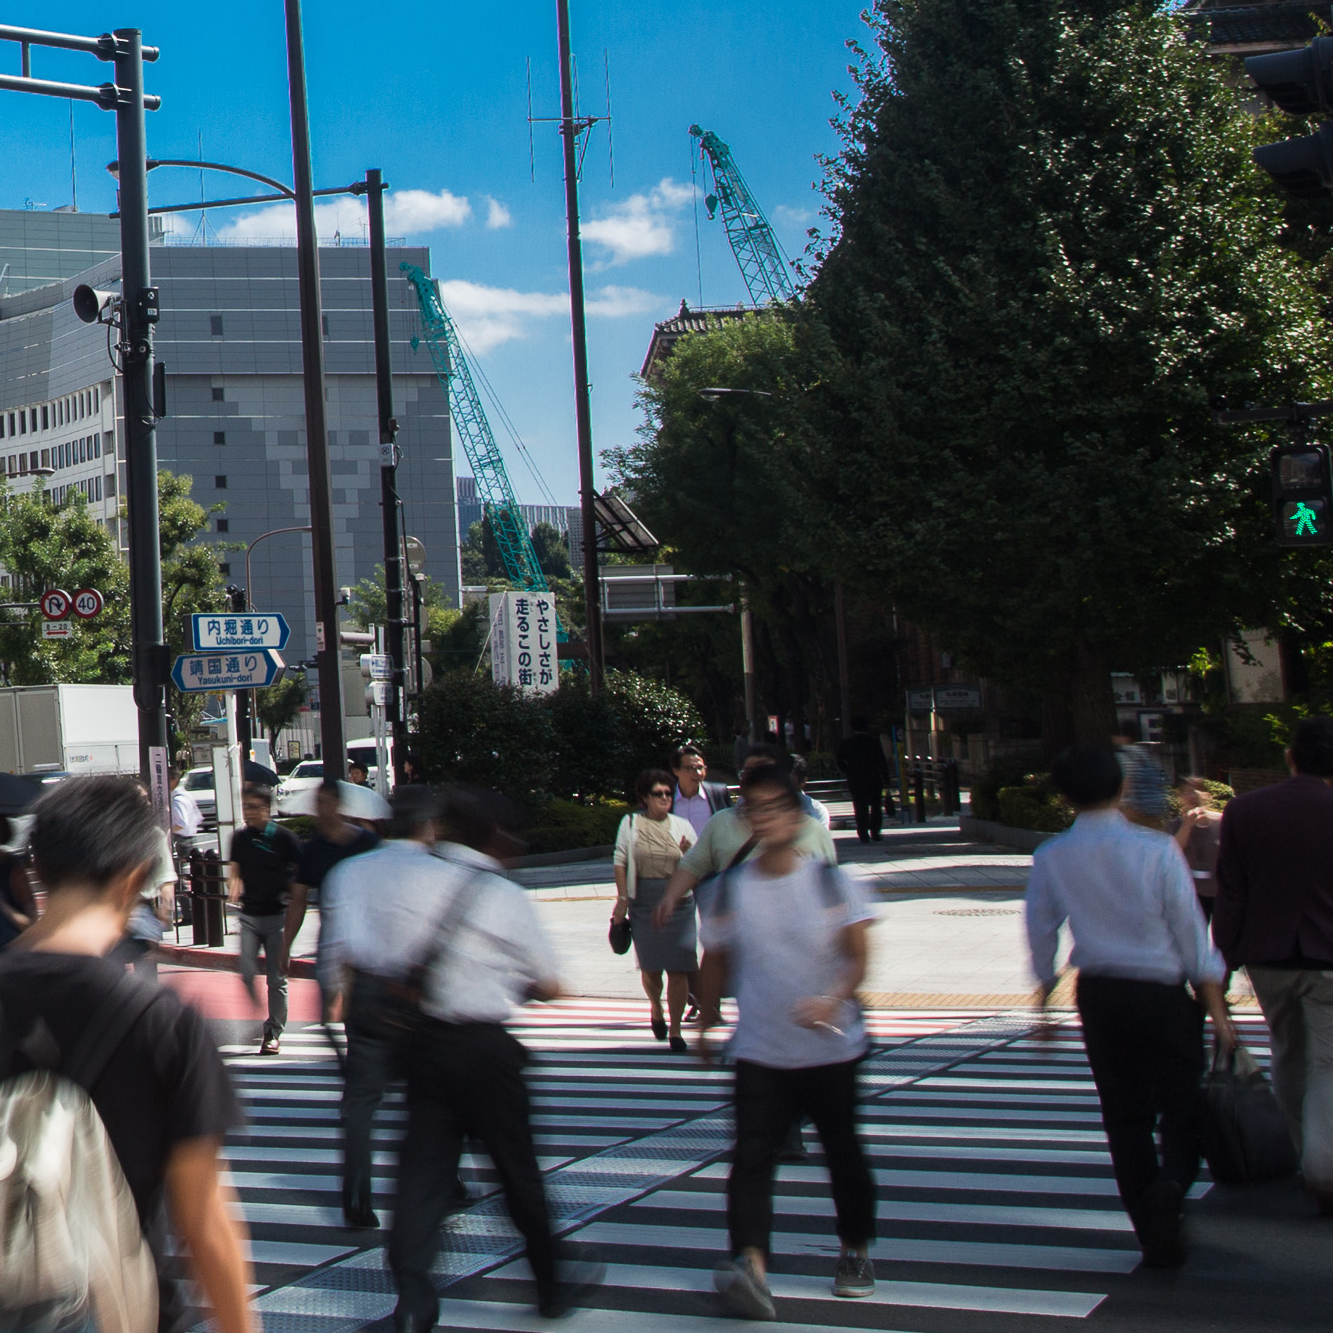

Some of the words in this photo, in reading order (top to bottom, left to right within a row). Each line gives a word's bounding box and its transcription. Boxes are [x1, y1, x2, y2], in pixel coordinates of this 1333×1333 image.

[78, 597, 96, 610] 40
[207, 619, 269, 636] 内堀通り
[216, 636, 264, 646] Uchibori-dori
[515, 598, 533, 686] 走るこの街
[536, 599, 552, 685] やさしさが
[189, 656, 257, 676] 靖国通り
[197, 673, 253, 685] Yasukuni-dori
